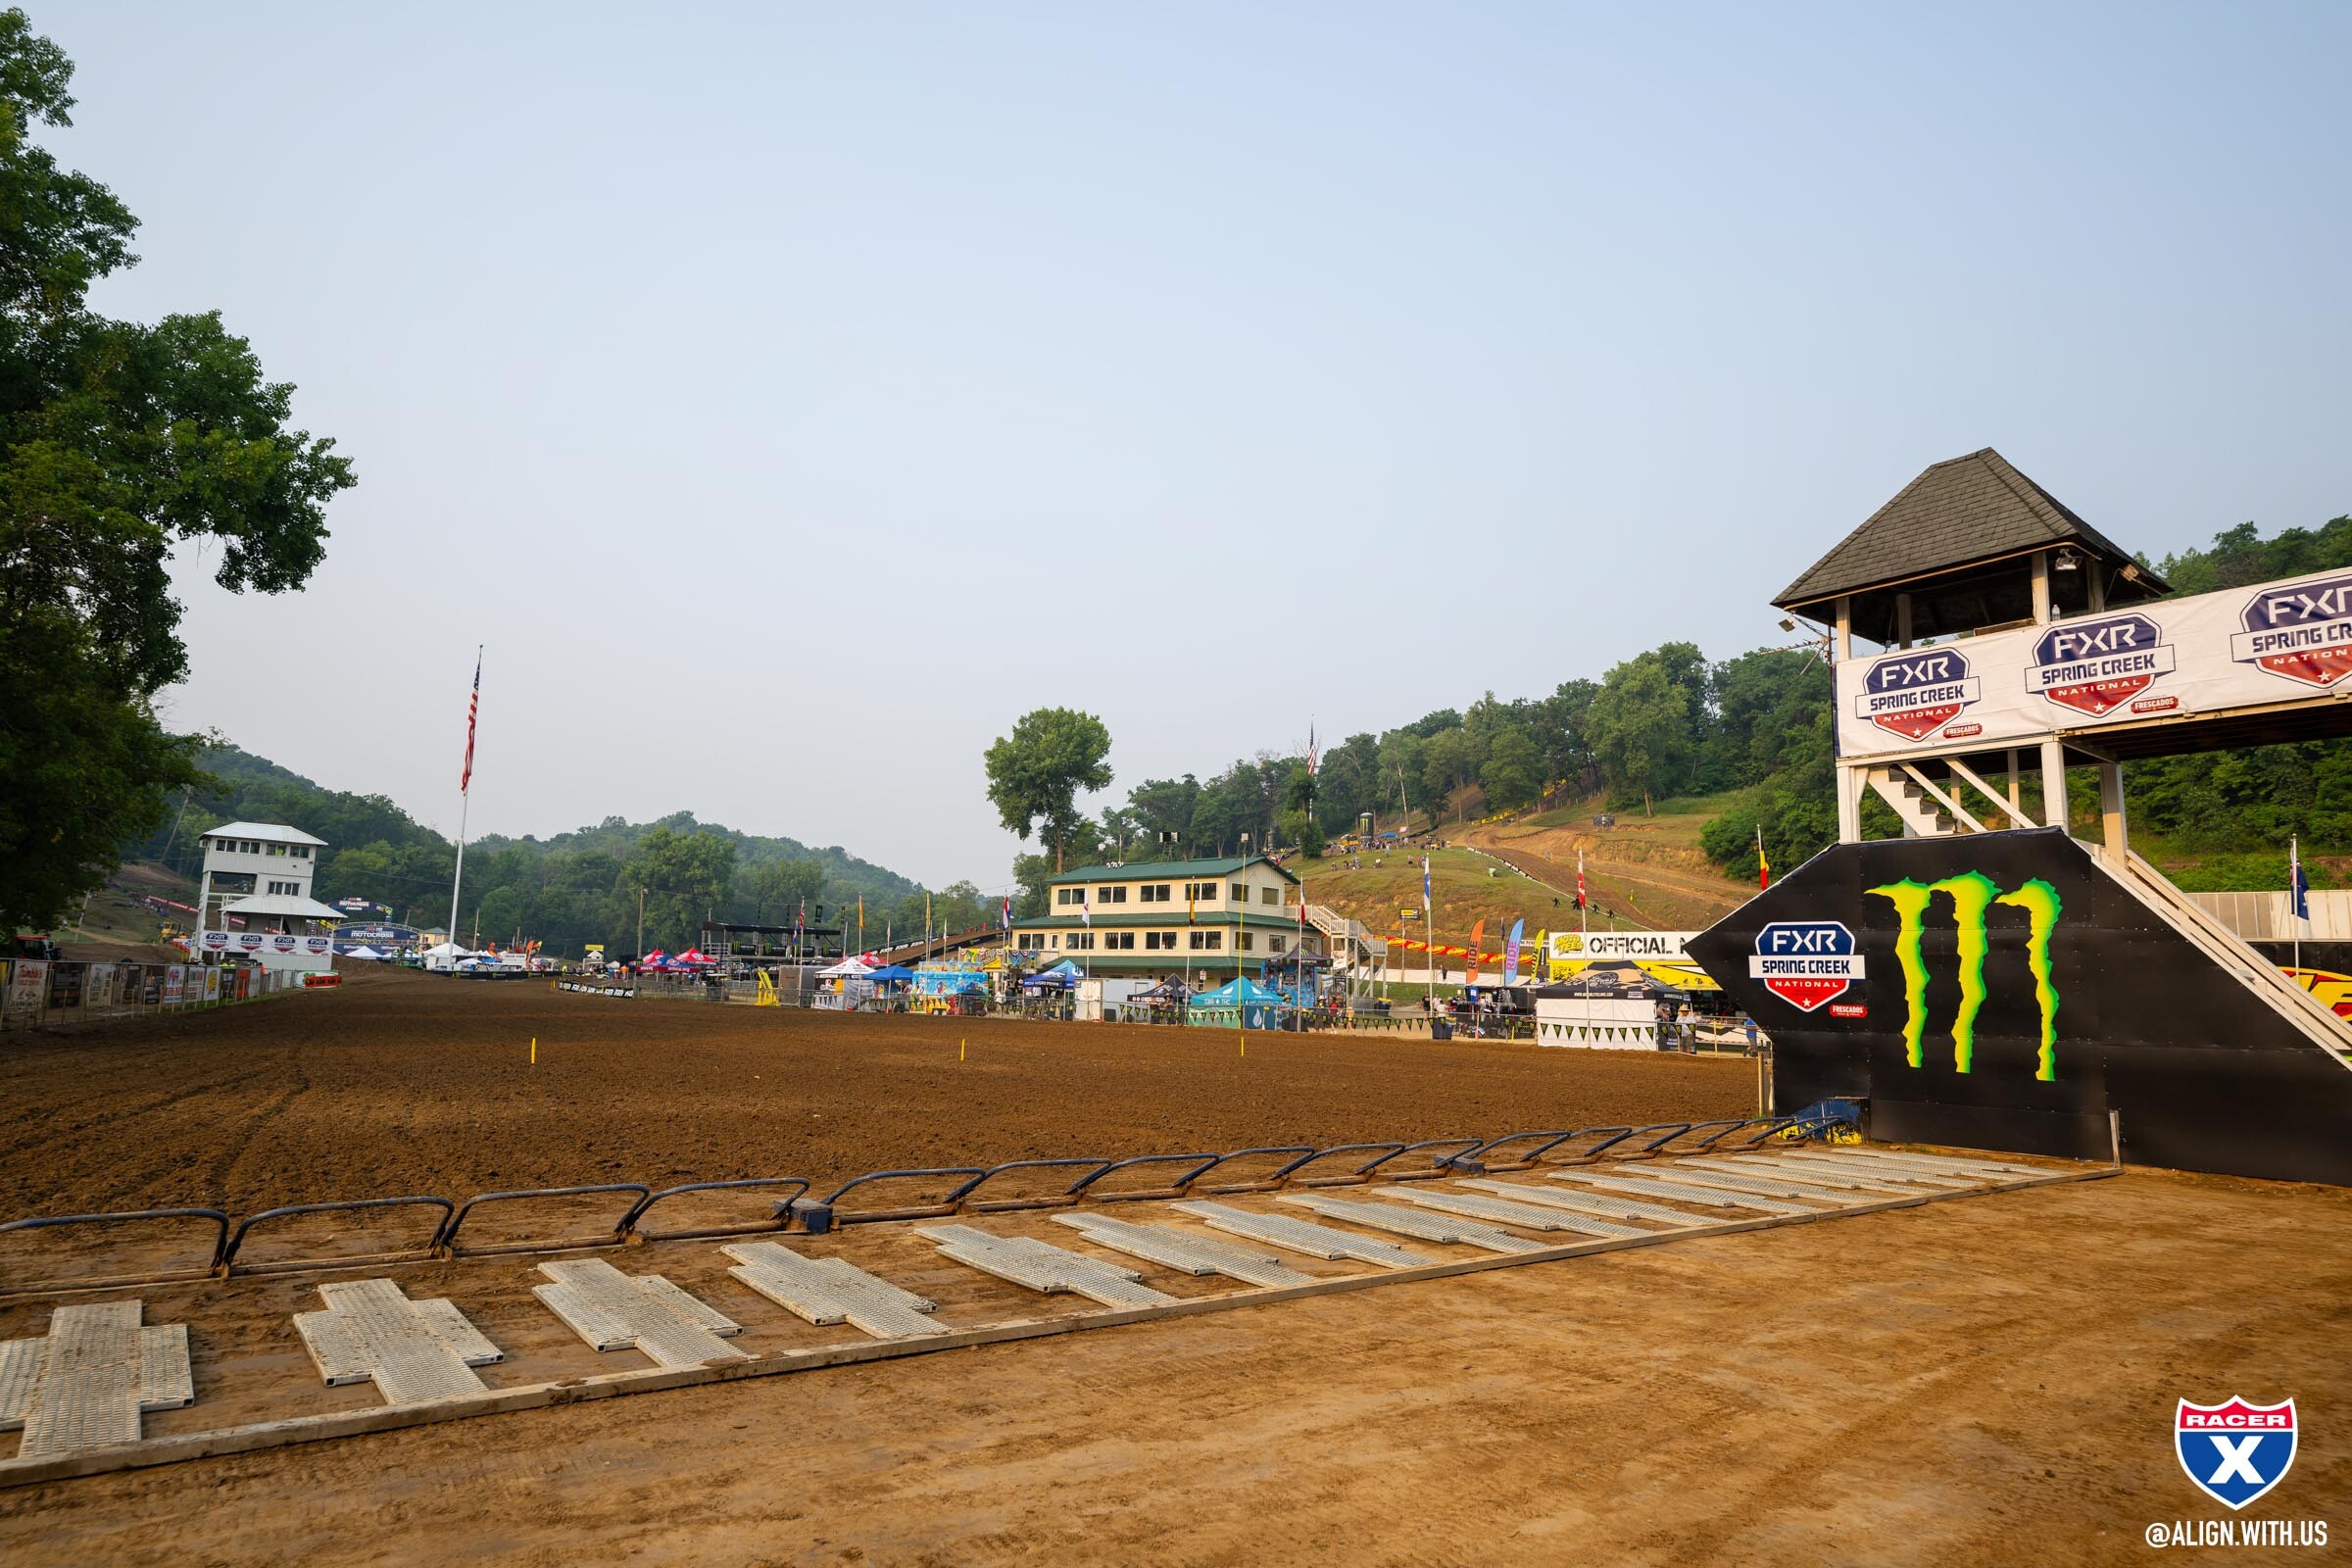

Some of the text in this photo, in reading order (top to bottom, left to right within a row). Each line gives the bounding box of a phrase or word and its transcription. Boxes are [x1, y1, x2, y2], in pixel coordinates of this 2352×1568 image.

[2054, 622, 2137, 660] FXR
[2252, 627, 2323, 654] SPRING
[1881, 656, 1950, 689] FXR
[2041, 653, 2156, 685] SPRING CREEK
[1870, 684, 1965, 711] SPRING CREEK
[2058, 679, 2140, 697] NATIONAL
[2134, 697, 2175, 710] FRESCADOS
[1884, 708, 1952, 722] NATIONAL
[1946, 724, 1980, 735] FRESCADOS
[1554, 934, 1581, 947] MOTO
[1589, 937, 1674, 955] OFFICIAL
[1772, 930, 1837, 953] FXR
[1468, 940, 1479, 969] RIDE
[1505, 940, 1517, 971] RIDE
[1762, 960, 1850, 974] SPRING CREEK
[1833, 1004, 1863, 1013] FRESCADOS
